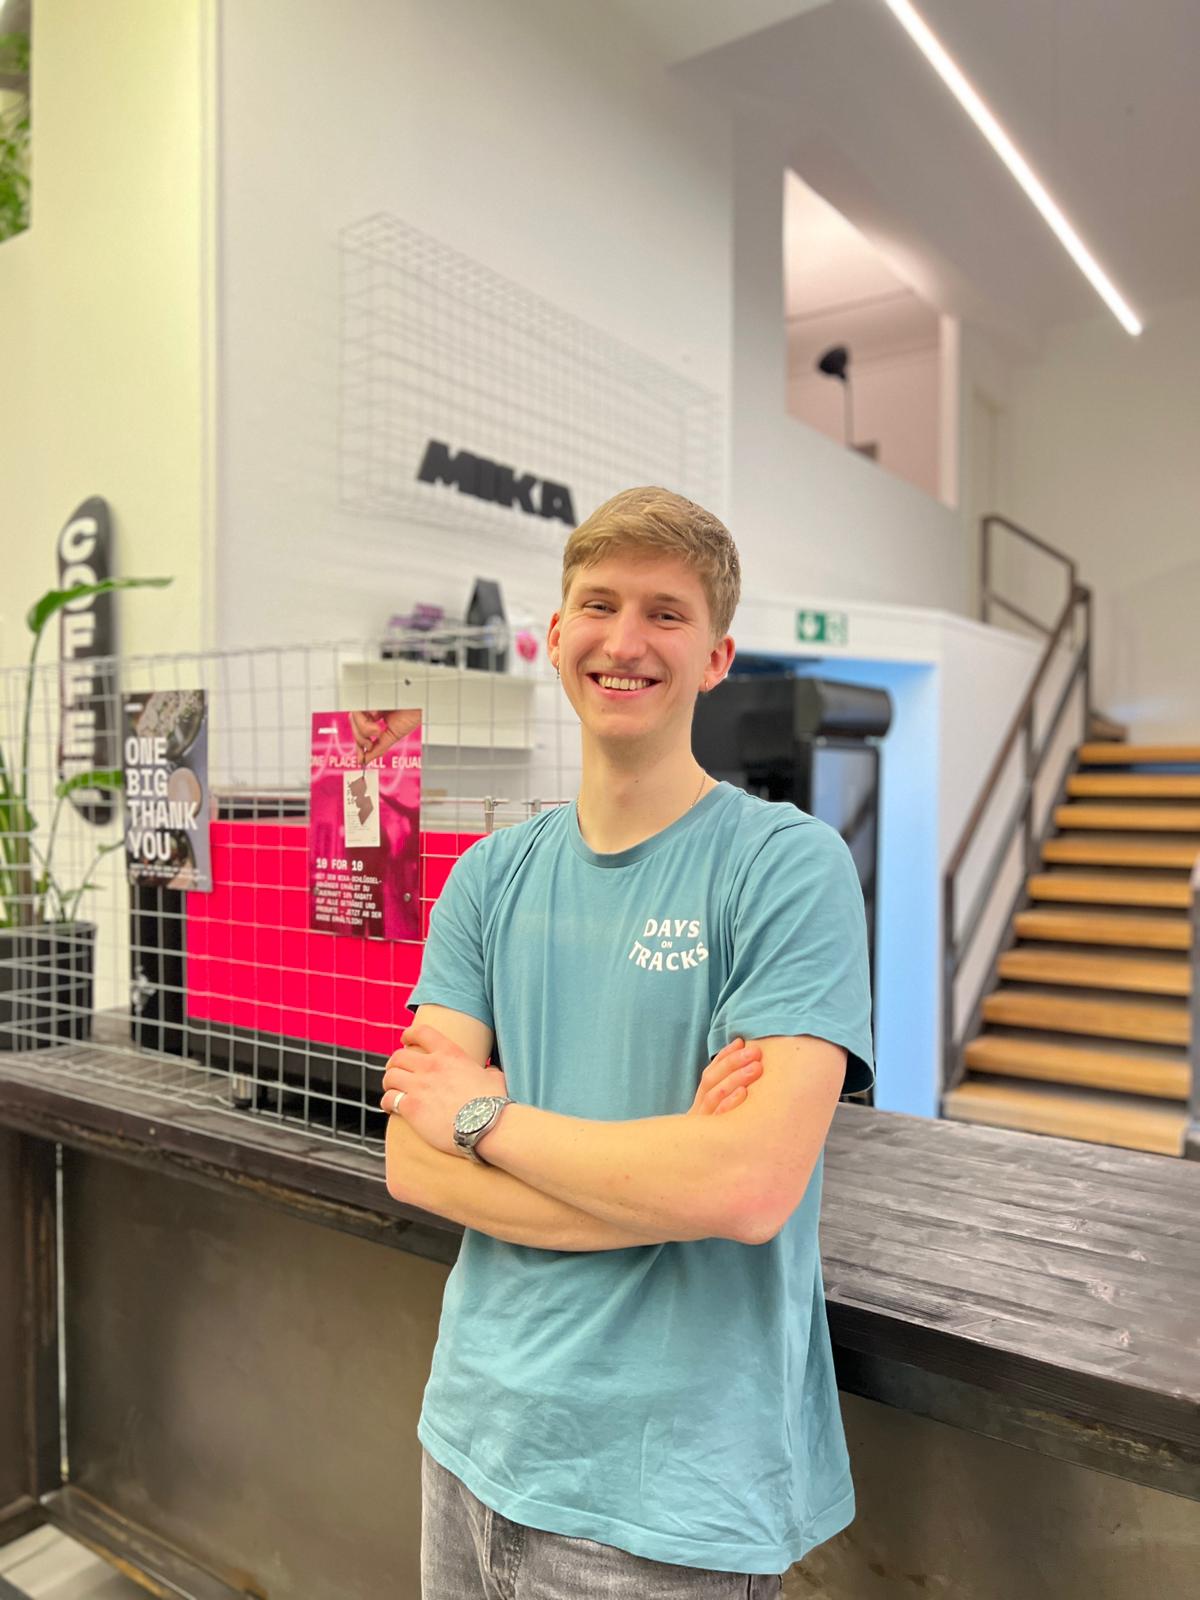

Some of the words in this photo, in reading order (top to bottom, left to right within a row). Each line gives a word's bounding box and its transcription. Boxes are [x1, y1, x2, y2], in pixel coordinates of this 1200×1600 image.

[418, 440, 577, 526] MIKA
[125, 735, 168, 766] ONE
[126, 768, 169, 797] BIG
[127, 799, 198, 830] THANK
[128, 830, 172, 861] YOU
[316, 858, 327, 868] 10
[332, 859, 347, 869] FOR
[352, 860, 363, 870] 10
[643, 918, 701, 938] DAYS
[628, 940, 709, 972] TRACKS
[661, 940, 673, 949] ON
